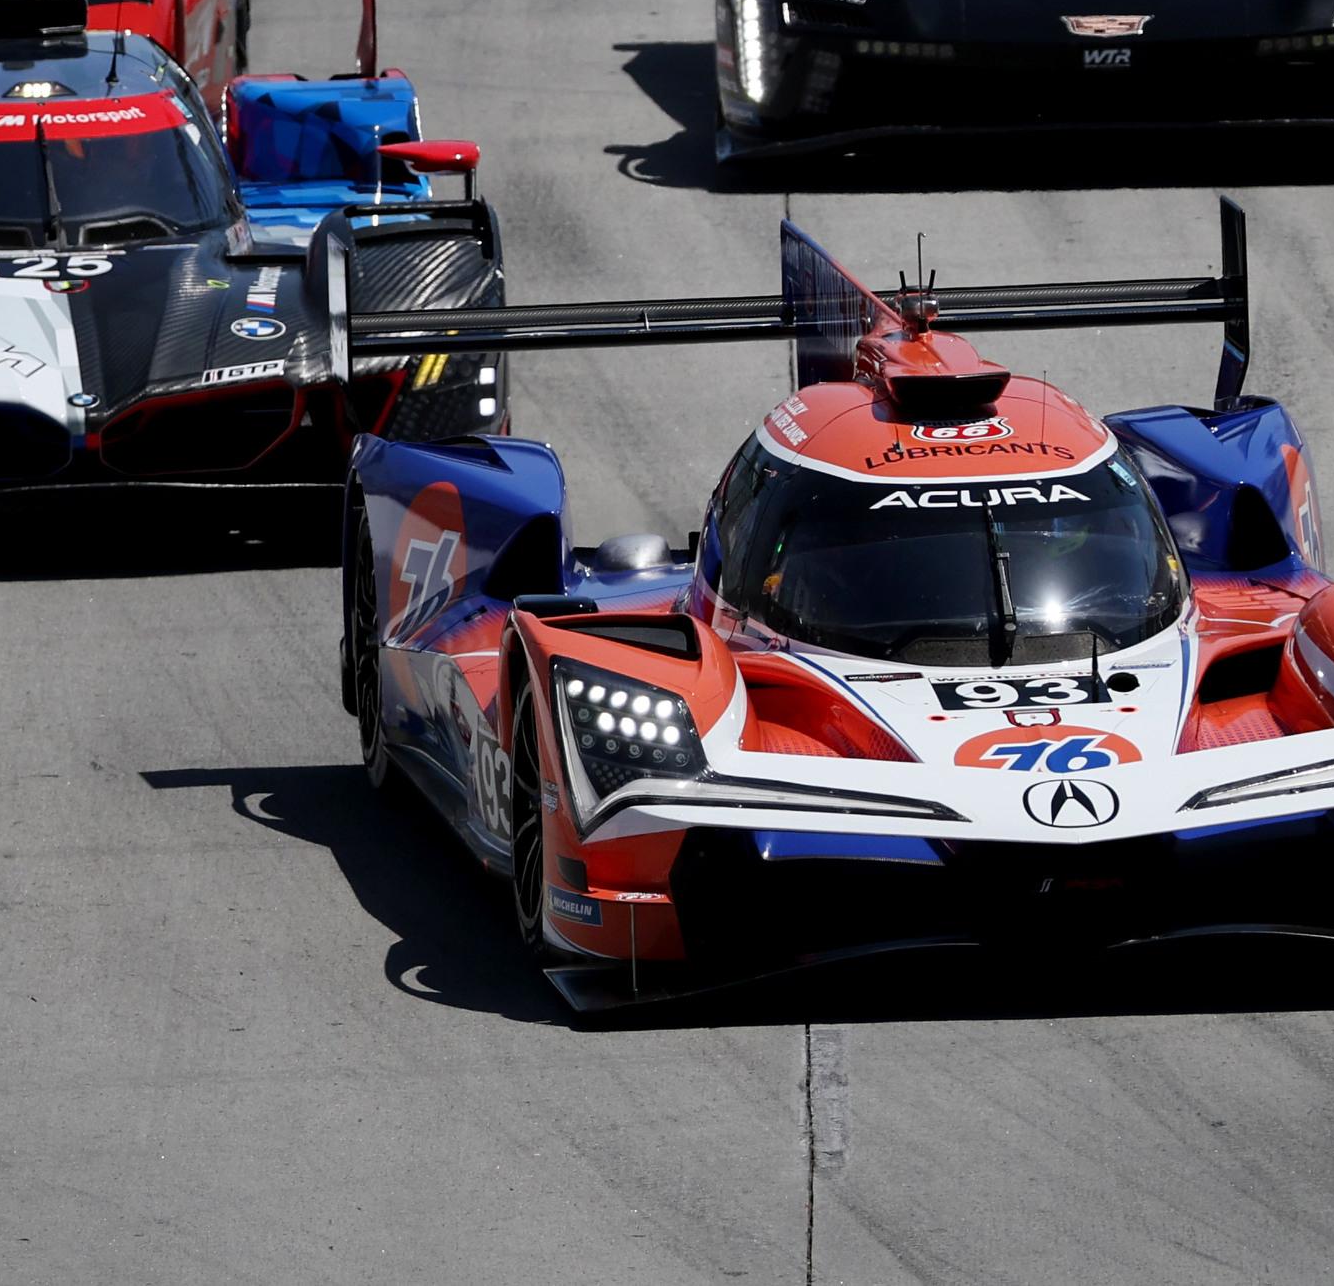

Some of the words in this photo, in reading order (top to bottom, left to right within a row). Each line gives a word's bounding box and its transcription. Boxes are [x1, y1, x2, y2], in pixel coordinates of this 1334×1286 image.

[1084, 48, 1131, 64] WTR
[33, 105, 146, 126] Motorsport
[12, 255, 113, 277] 25
[228, 362, 279, 377] GTP
[931, 425, 991, 439] 66
[864, 442, 1076, 470] LUBRICANTS
[869, 484, 1092, 510] ACURA
[955, 677, 1088, 708] 93
[985, 735, 1112, 774] 76
[554, 895, 593, 916] MICHELIN
